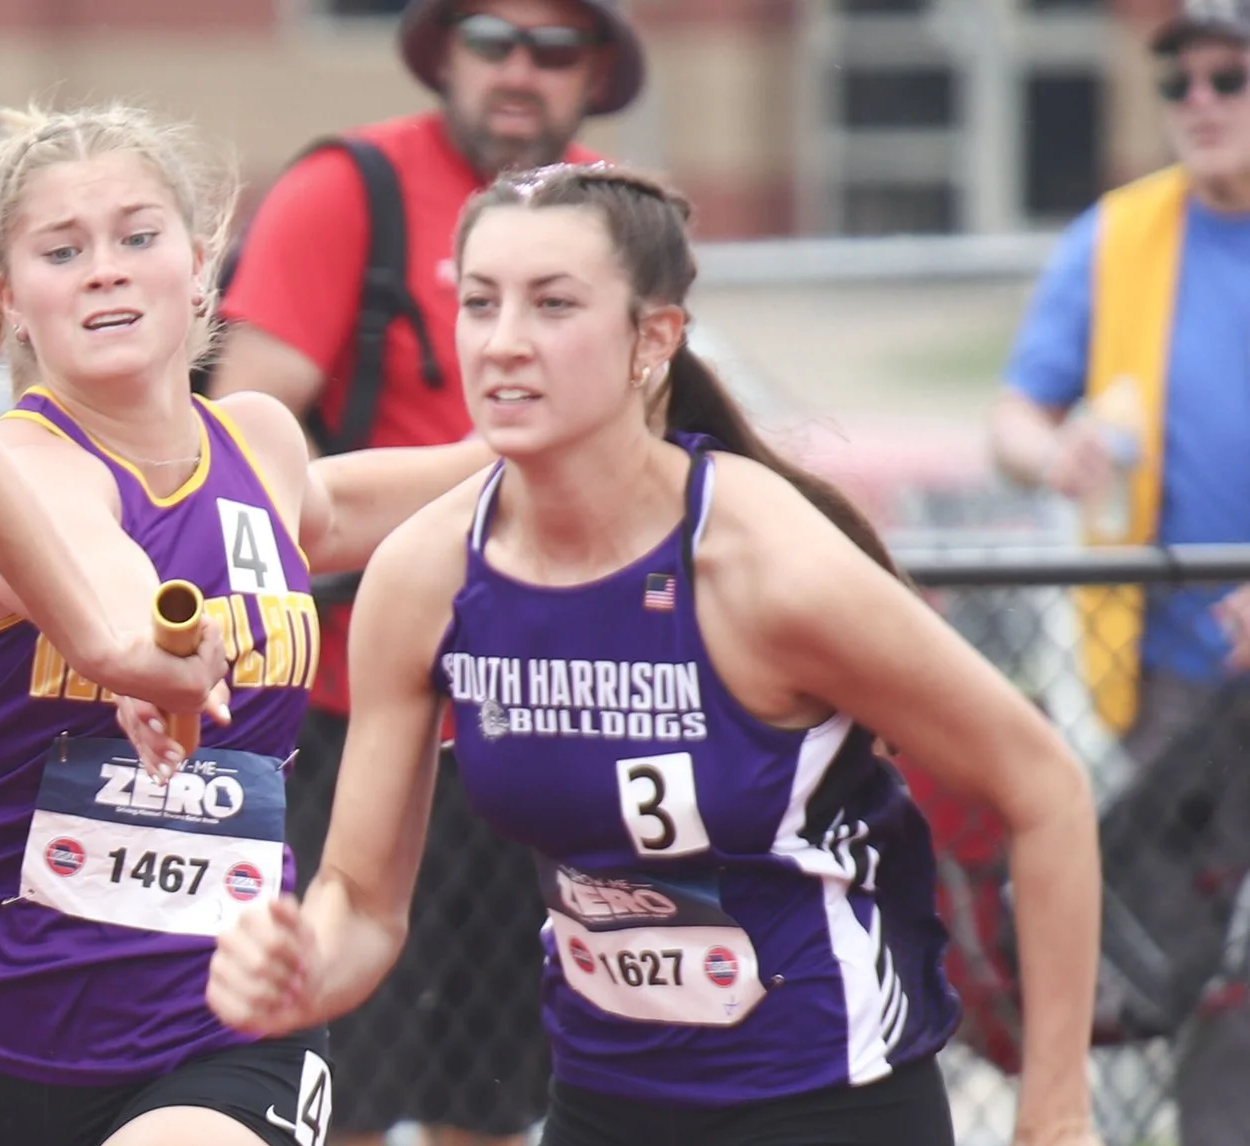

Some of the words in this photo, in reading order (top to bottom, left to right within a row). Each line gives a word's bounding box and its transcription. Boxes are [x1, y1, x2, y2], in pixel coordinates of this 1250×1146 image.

[232, 510, 268, 588] 4
[528, 658, 702, 712] HARRISON
[507, 706, 708, 739] BULLDOGS
[94, 762, 245, 819] ZERO
[628, 763, 677, 850] 3
[108, 846, 210, 896] 1467
[598, 947, 684, 987] 1627
